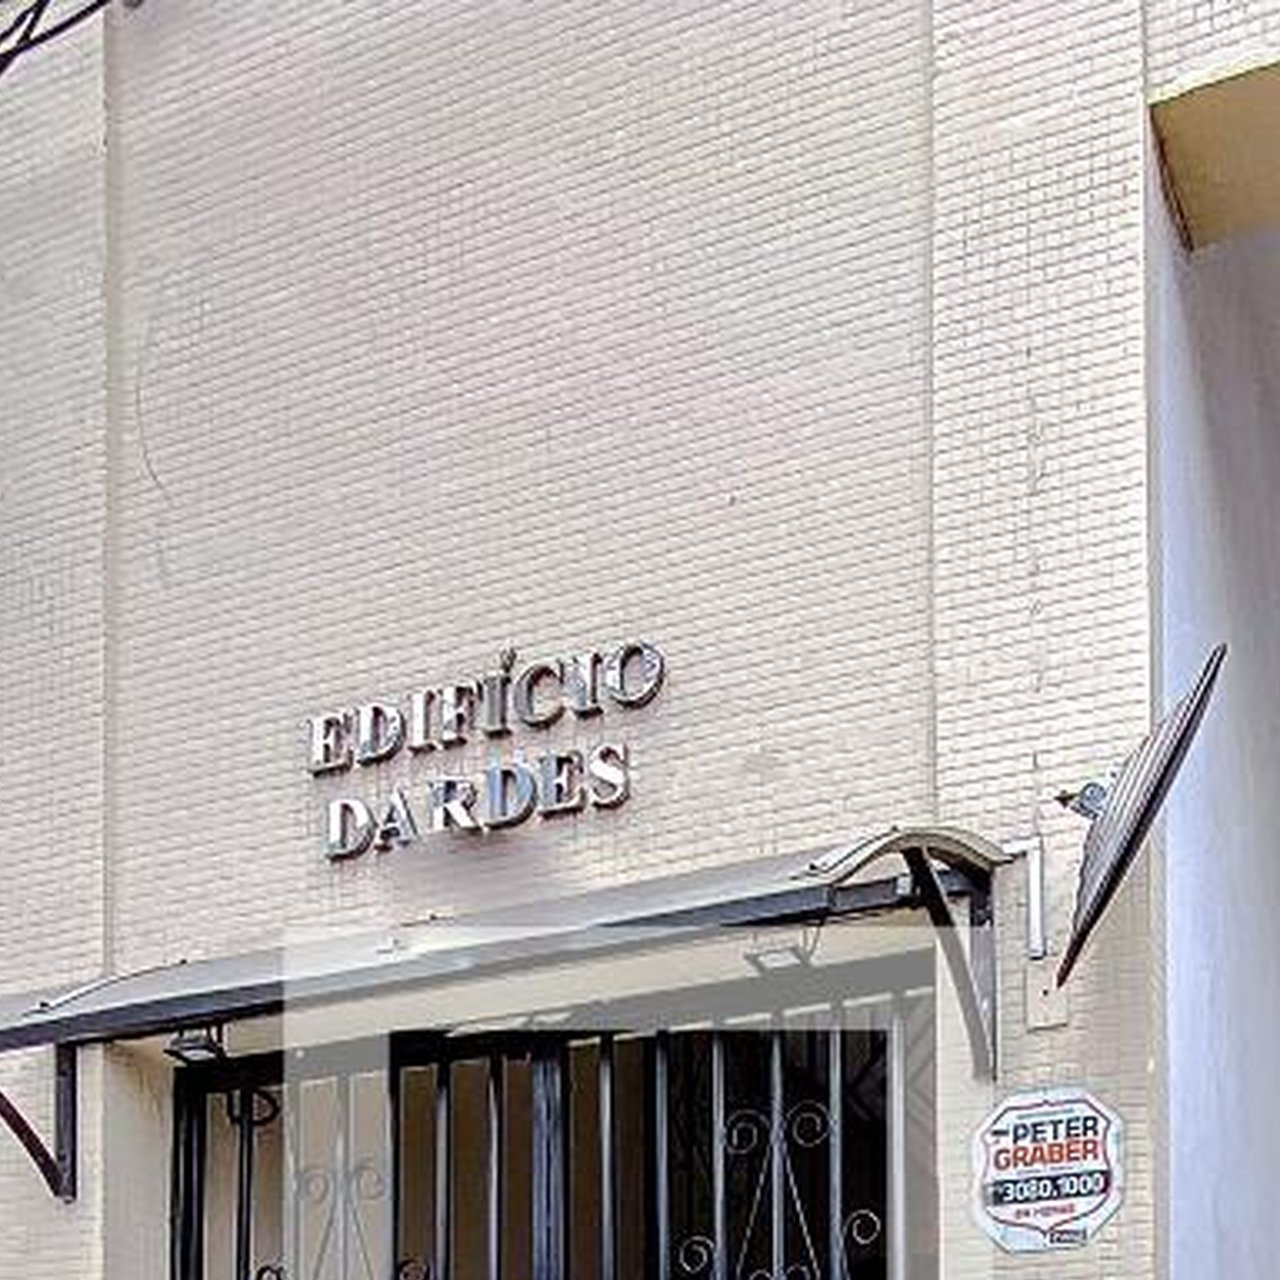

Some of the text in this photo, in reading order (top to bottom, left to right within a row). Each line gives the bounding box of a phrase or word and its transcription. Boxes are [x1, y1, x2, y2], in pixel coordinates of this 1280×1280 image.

[308, 641, 665, 776] EDIFÍCIO
[325, 742, 631, 861] DARDES
[994, 1139, 1098, 1171] GRABER
[1013, 1116, 1098, 1144] PETER
